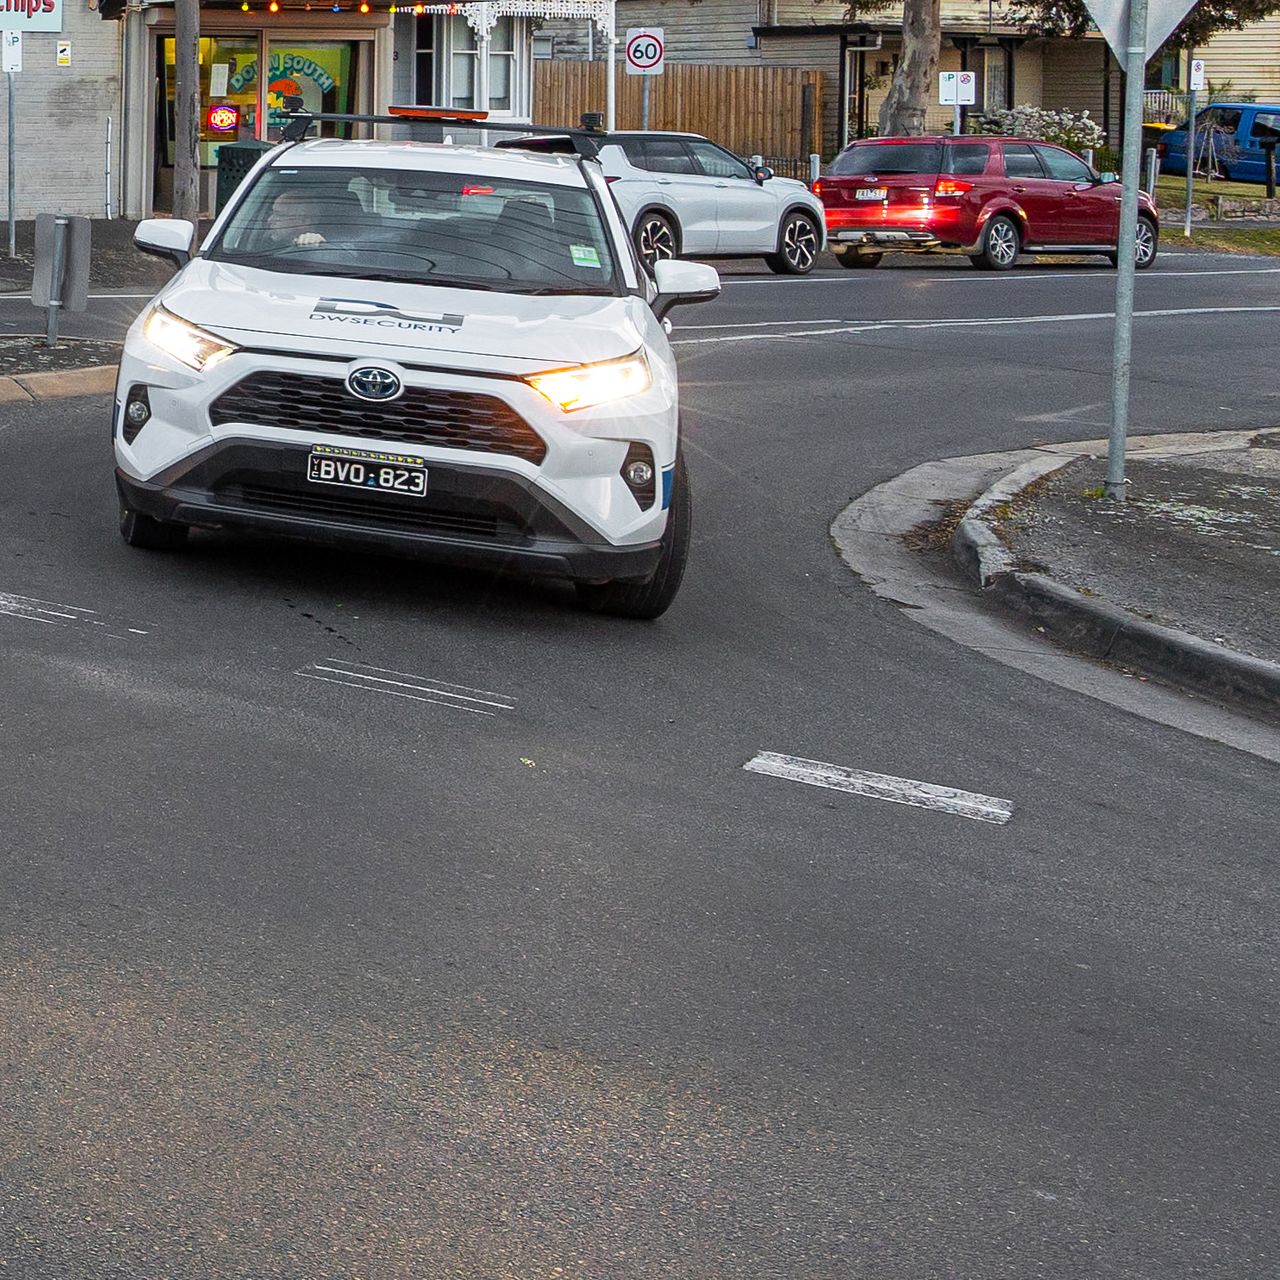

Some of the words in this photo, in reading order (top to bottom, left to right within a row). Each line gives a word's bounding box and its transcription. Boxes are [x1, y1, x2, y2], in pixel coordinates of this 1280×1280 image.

[633, 43, 657, 60] 60
[284, 53, 334, 94] SOUTH
[210, 112, 237, 126] OPEN
